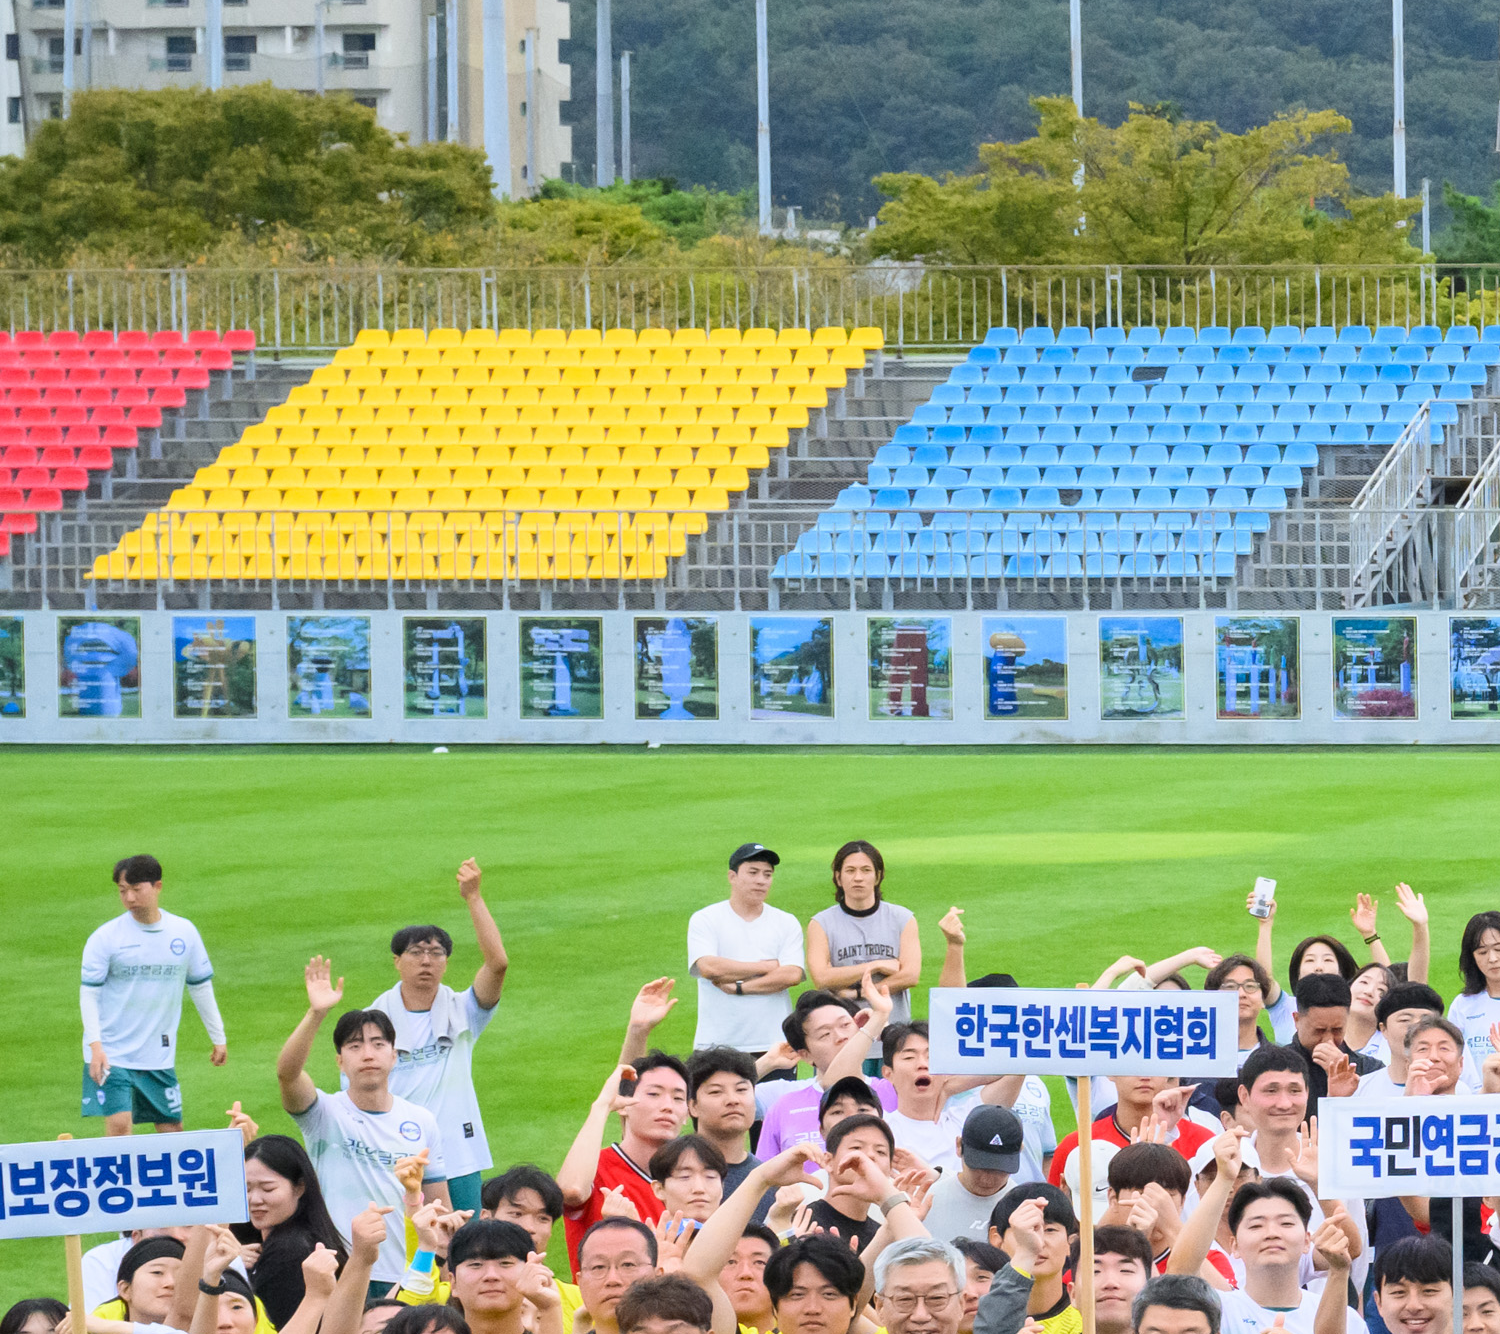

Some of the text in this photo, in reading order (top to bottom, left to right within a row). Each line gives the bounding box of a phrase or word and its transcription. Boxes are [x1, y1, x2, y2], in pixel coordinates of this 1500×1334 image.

[838, 945, 862, 961] SAINT
[955, 1002, 1217, 1060] 한국한센복지협회
[0, 1147, 219, 1221] 보장정보원
